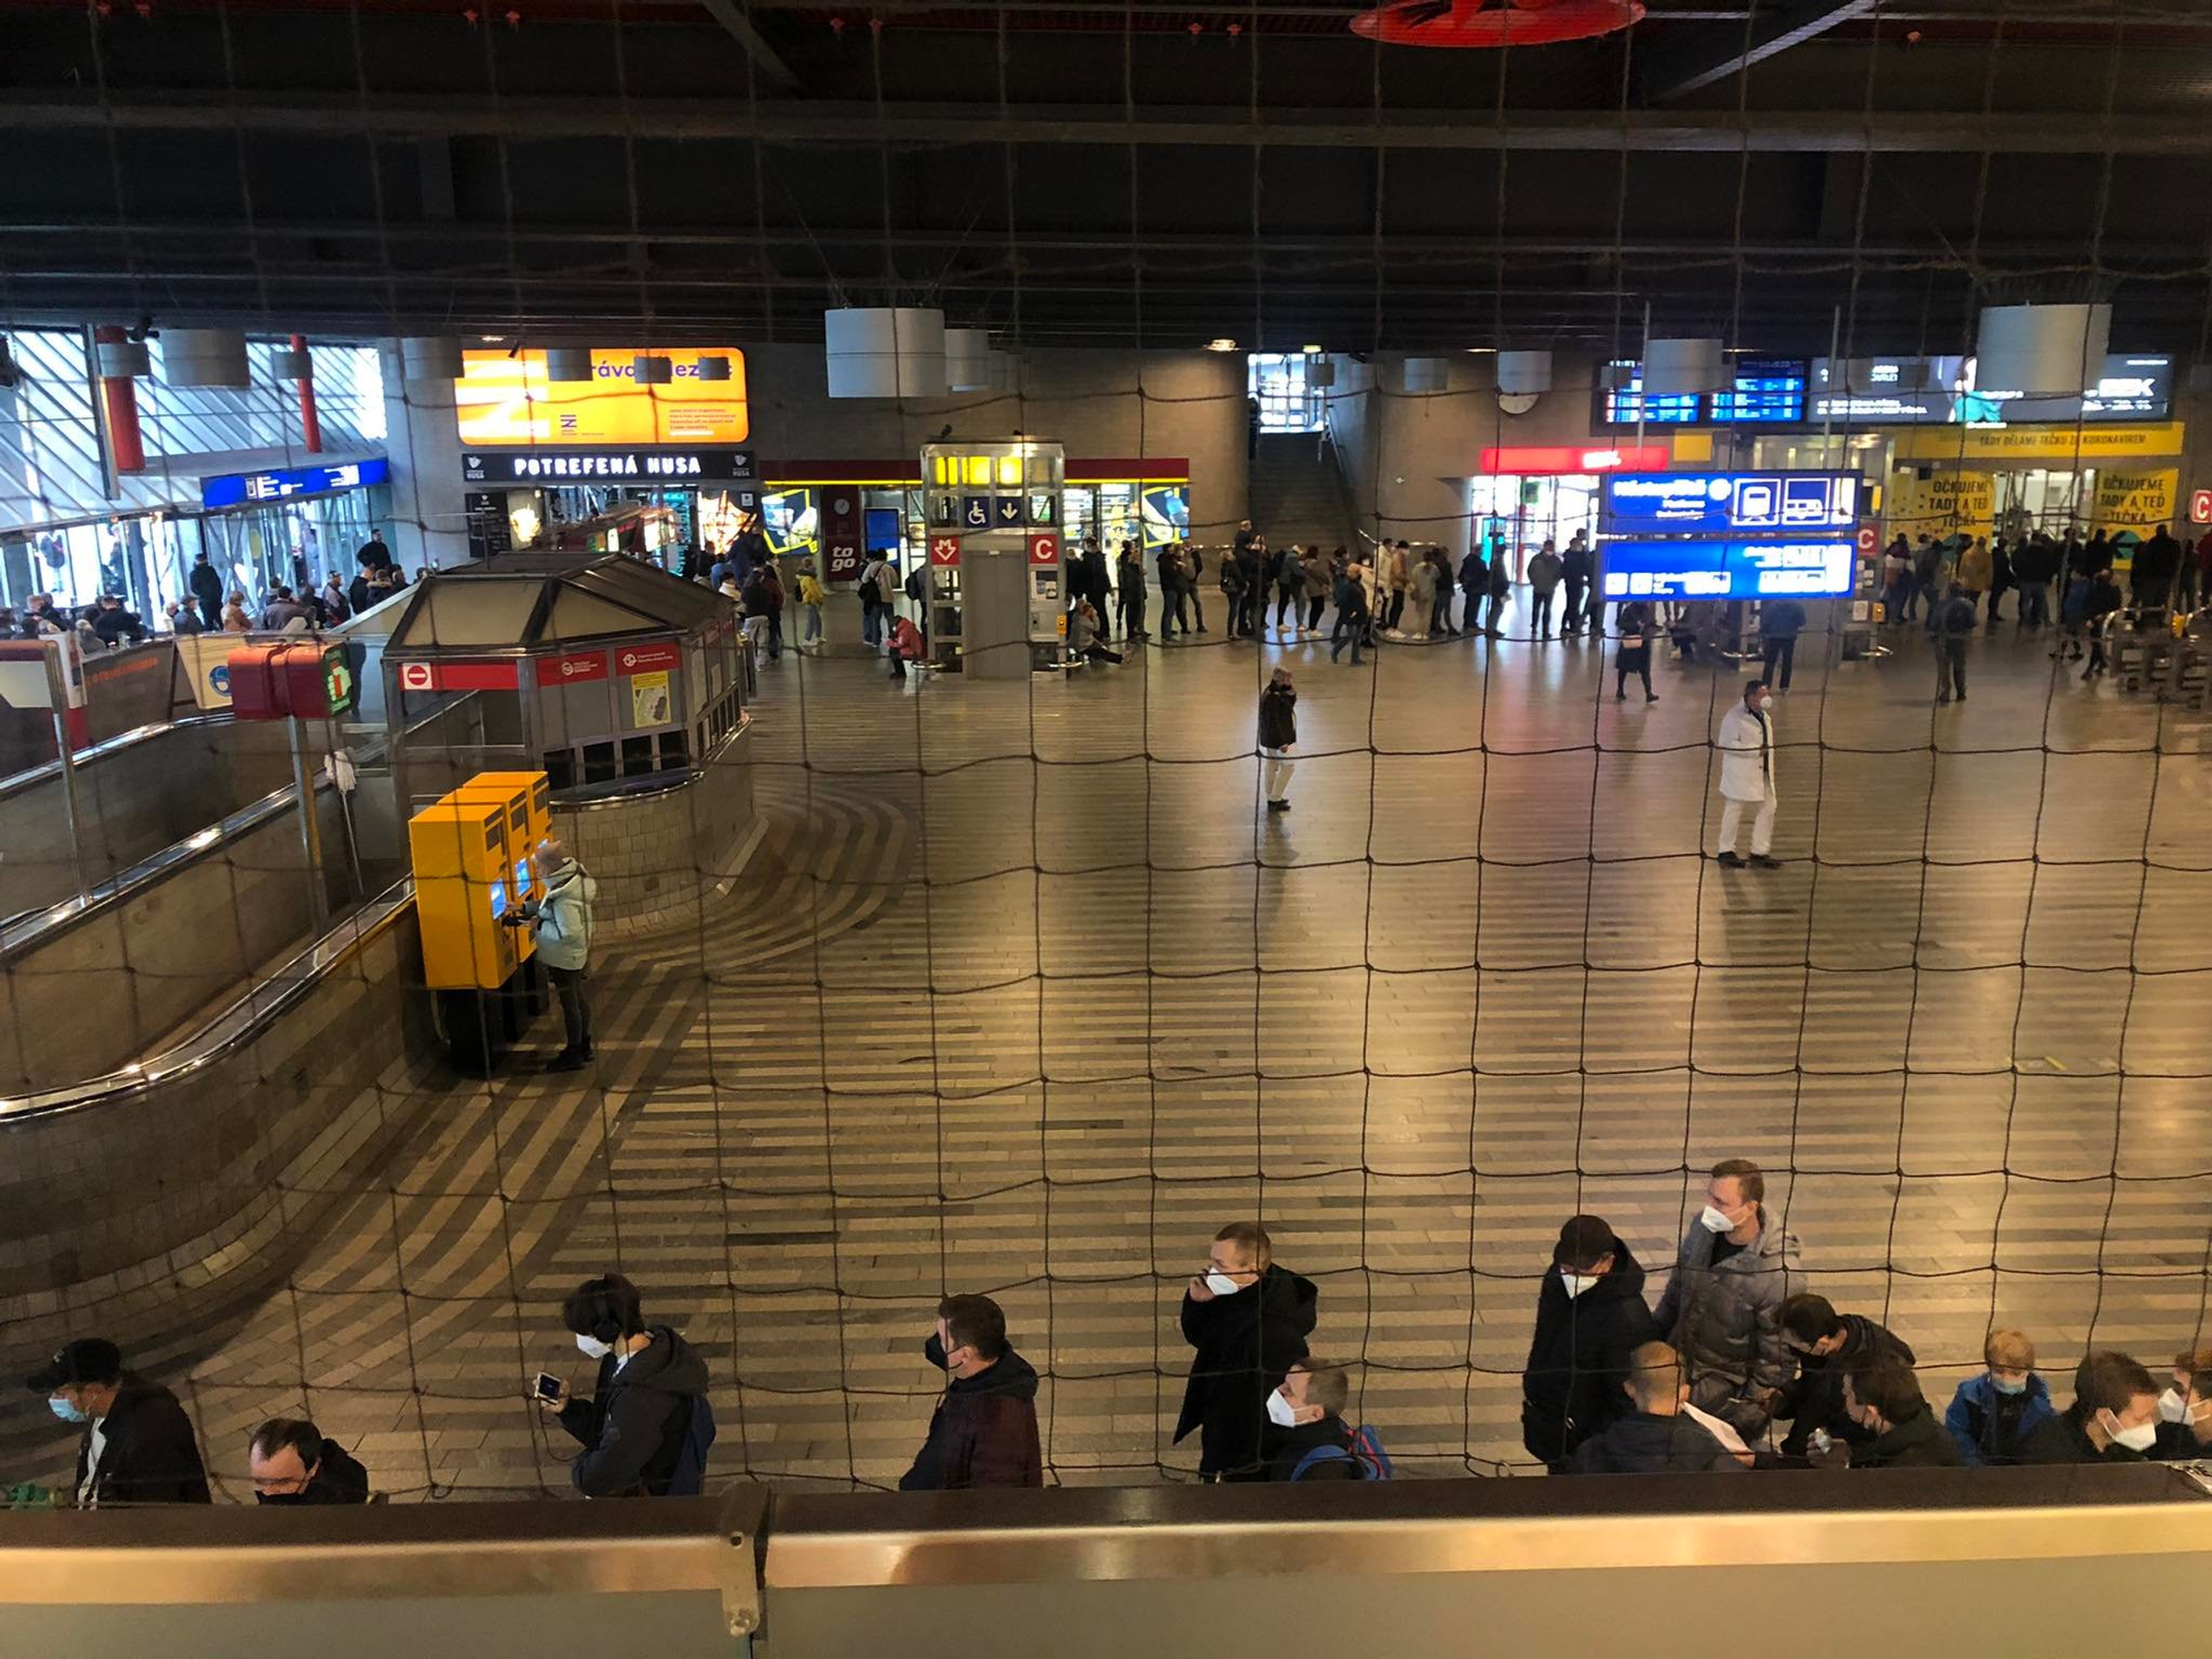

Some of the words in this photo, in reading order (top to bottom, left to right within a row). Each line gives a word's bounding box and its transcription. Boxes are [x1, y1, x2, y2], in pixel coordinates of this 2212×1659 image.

[514, 454, 639, 475] POTREFENÁ
[648, 457, 702, 474] HUSA
[2196, 495, 2209, 519] C
[1035, 538, 1053, 560] C
[1858, 528, 1875, 549] C
[832, 546, 854, 558] to
[830, 558, 856, 572] go
